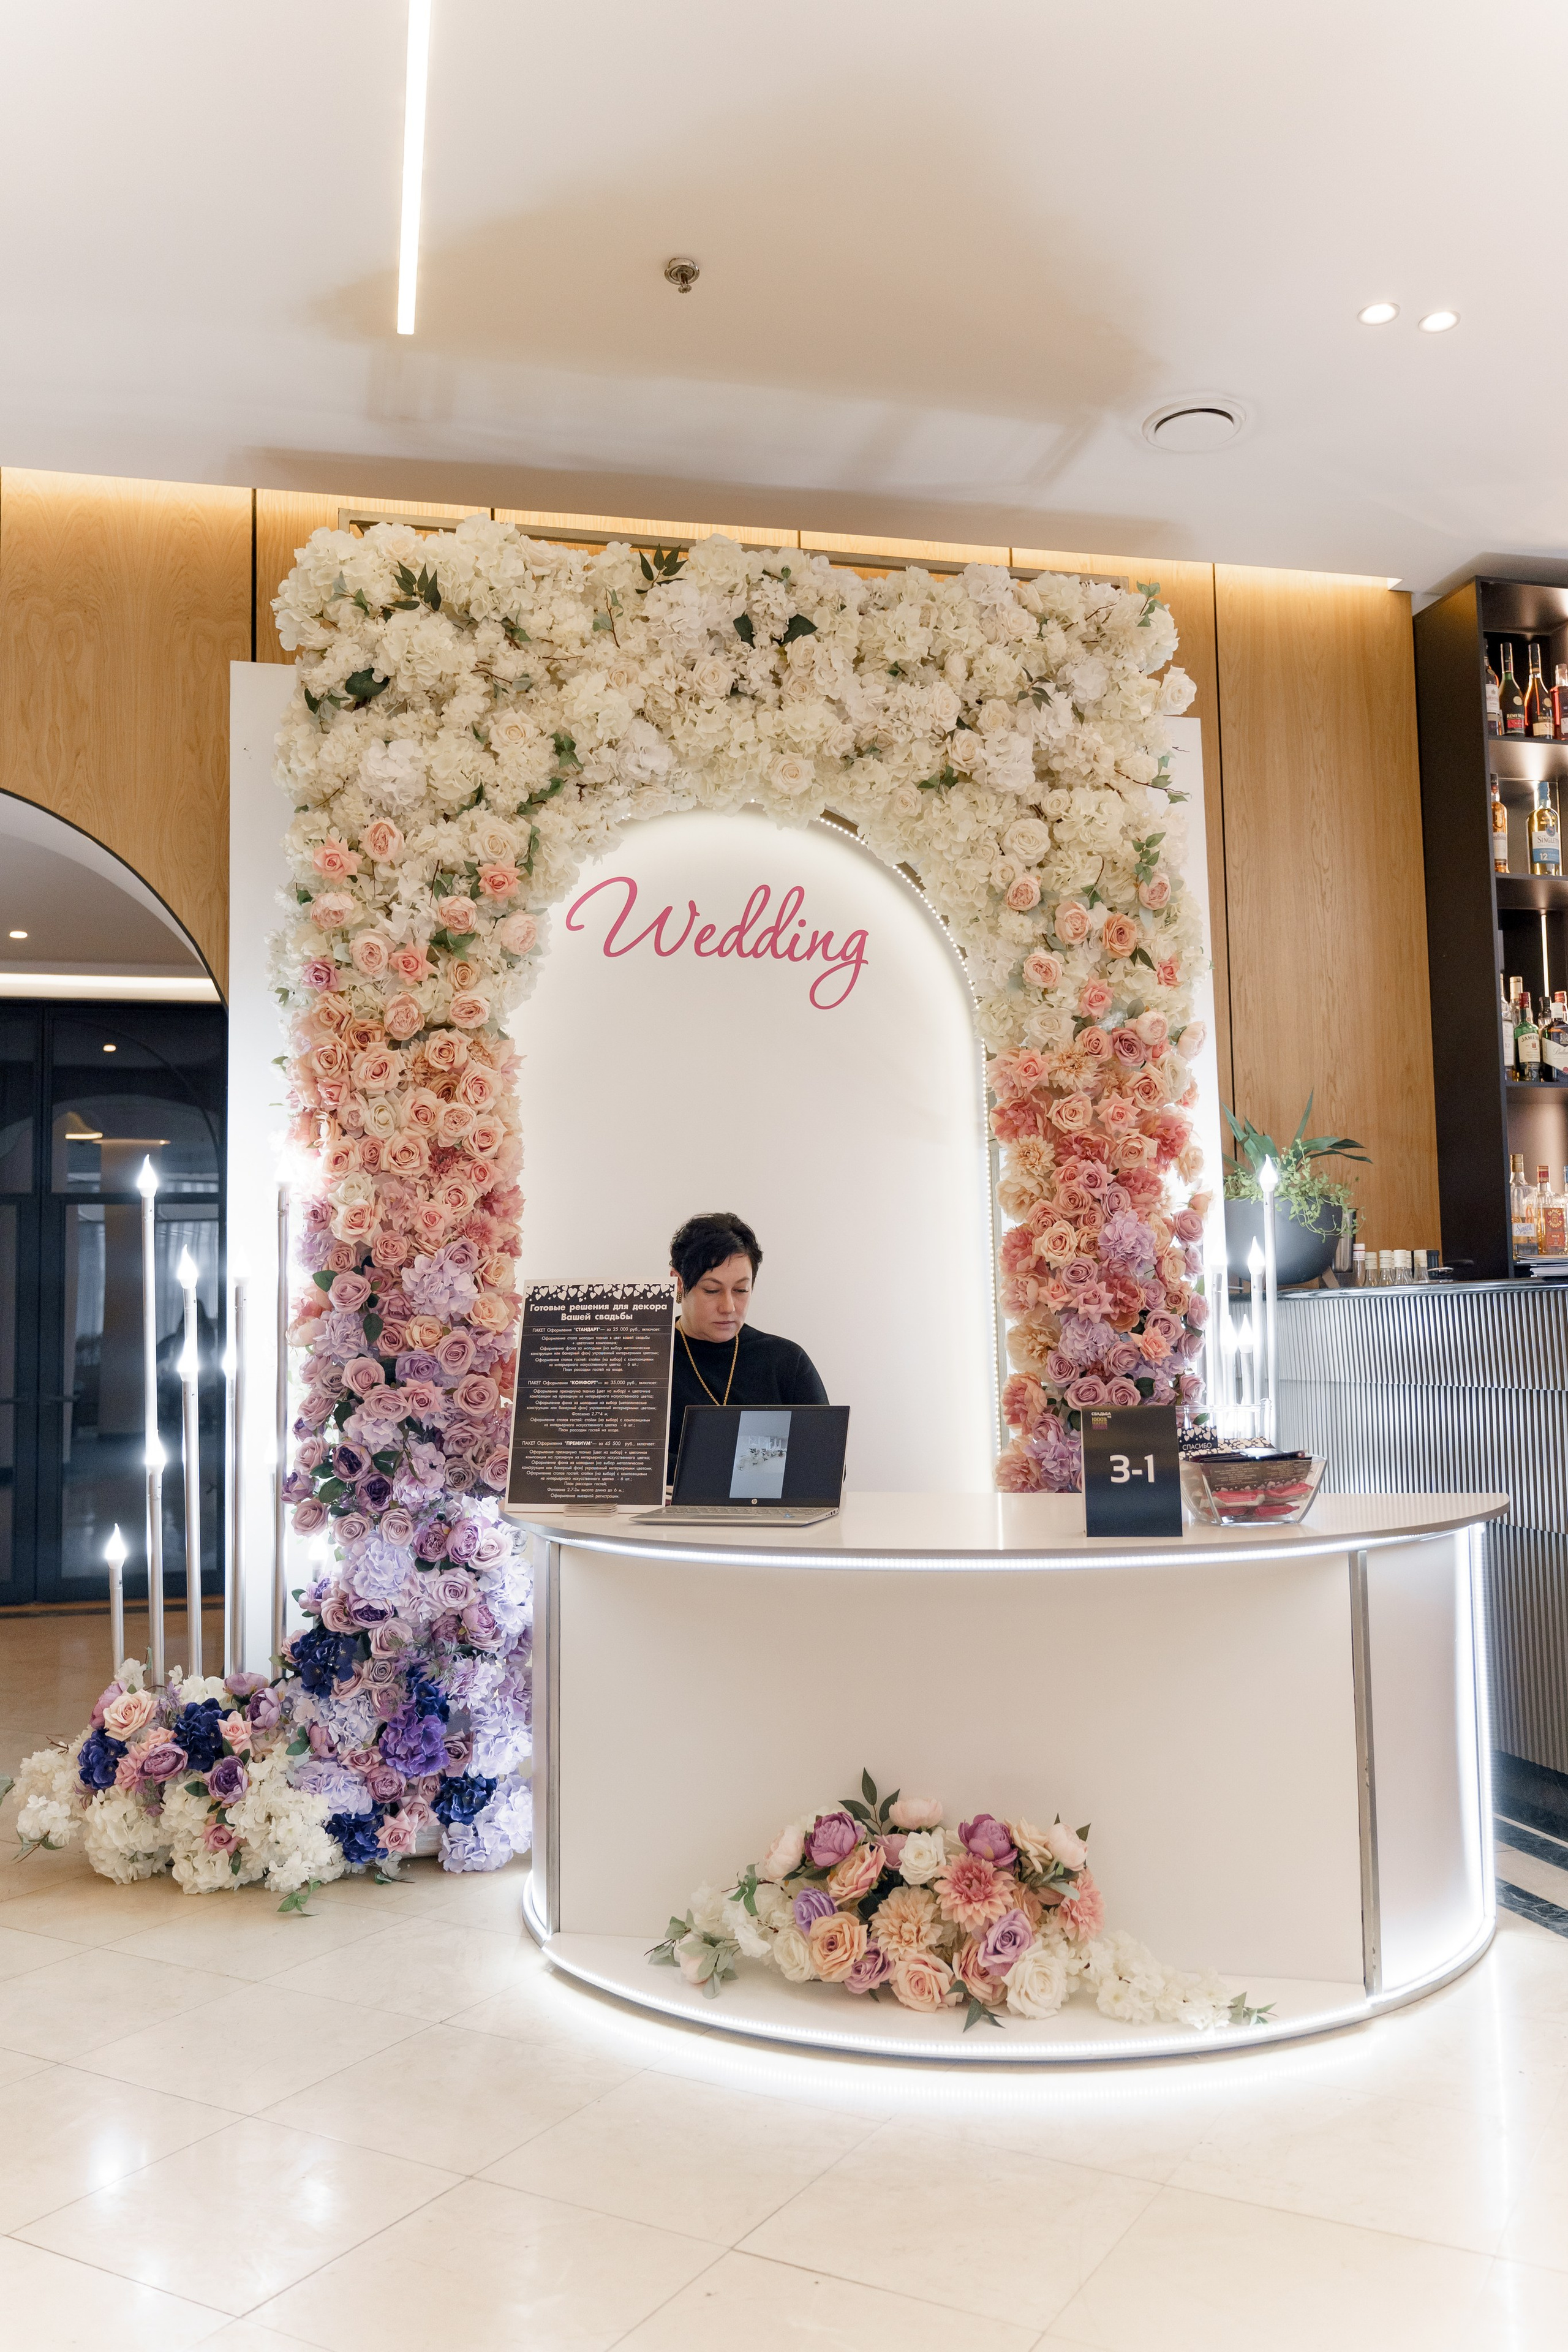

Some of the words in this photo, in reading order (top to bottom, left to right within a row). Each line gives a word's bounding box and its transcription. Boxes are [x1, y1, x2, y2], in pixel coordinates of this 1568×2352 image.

[565, 876, 869, 1010] Wedding
[569, 1304, 609, 1313] решения
[594, 1311, 633, 1321] свадьбы
[1182, 1442, 1212, 1450] СПАСИБО
[1109, 1453, 1155, 1483] 3-1
